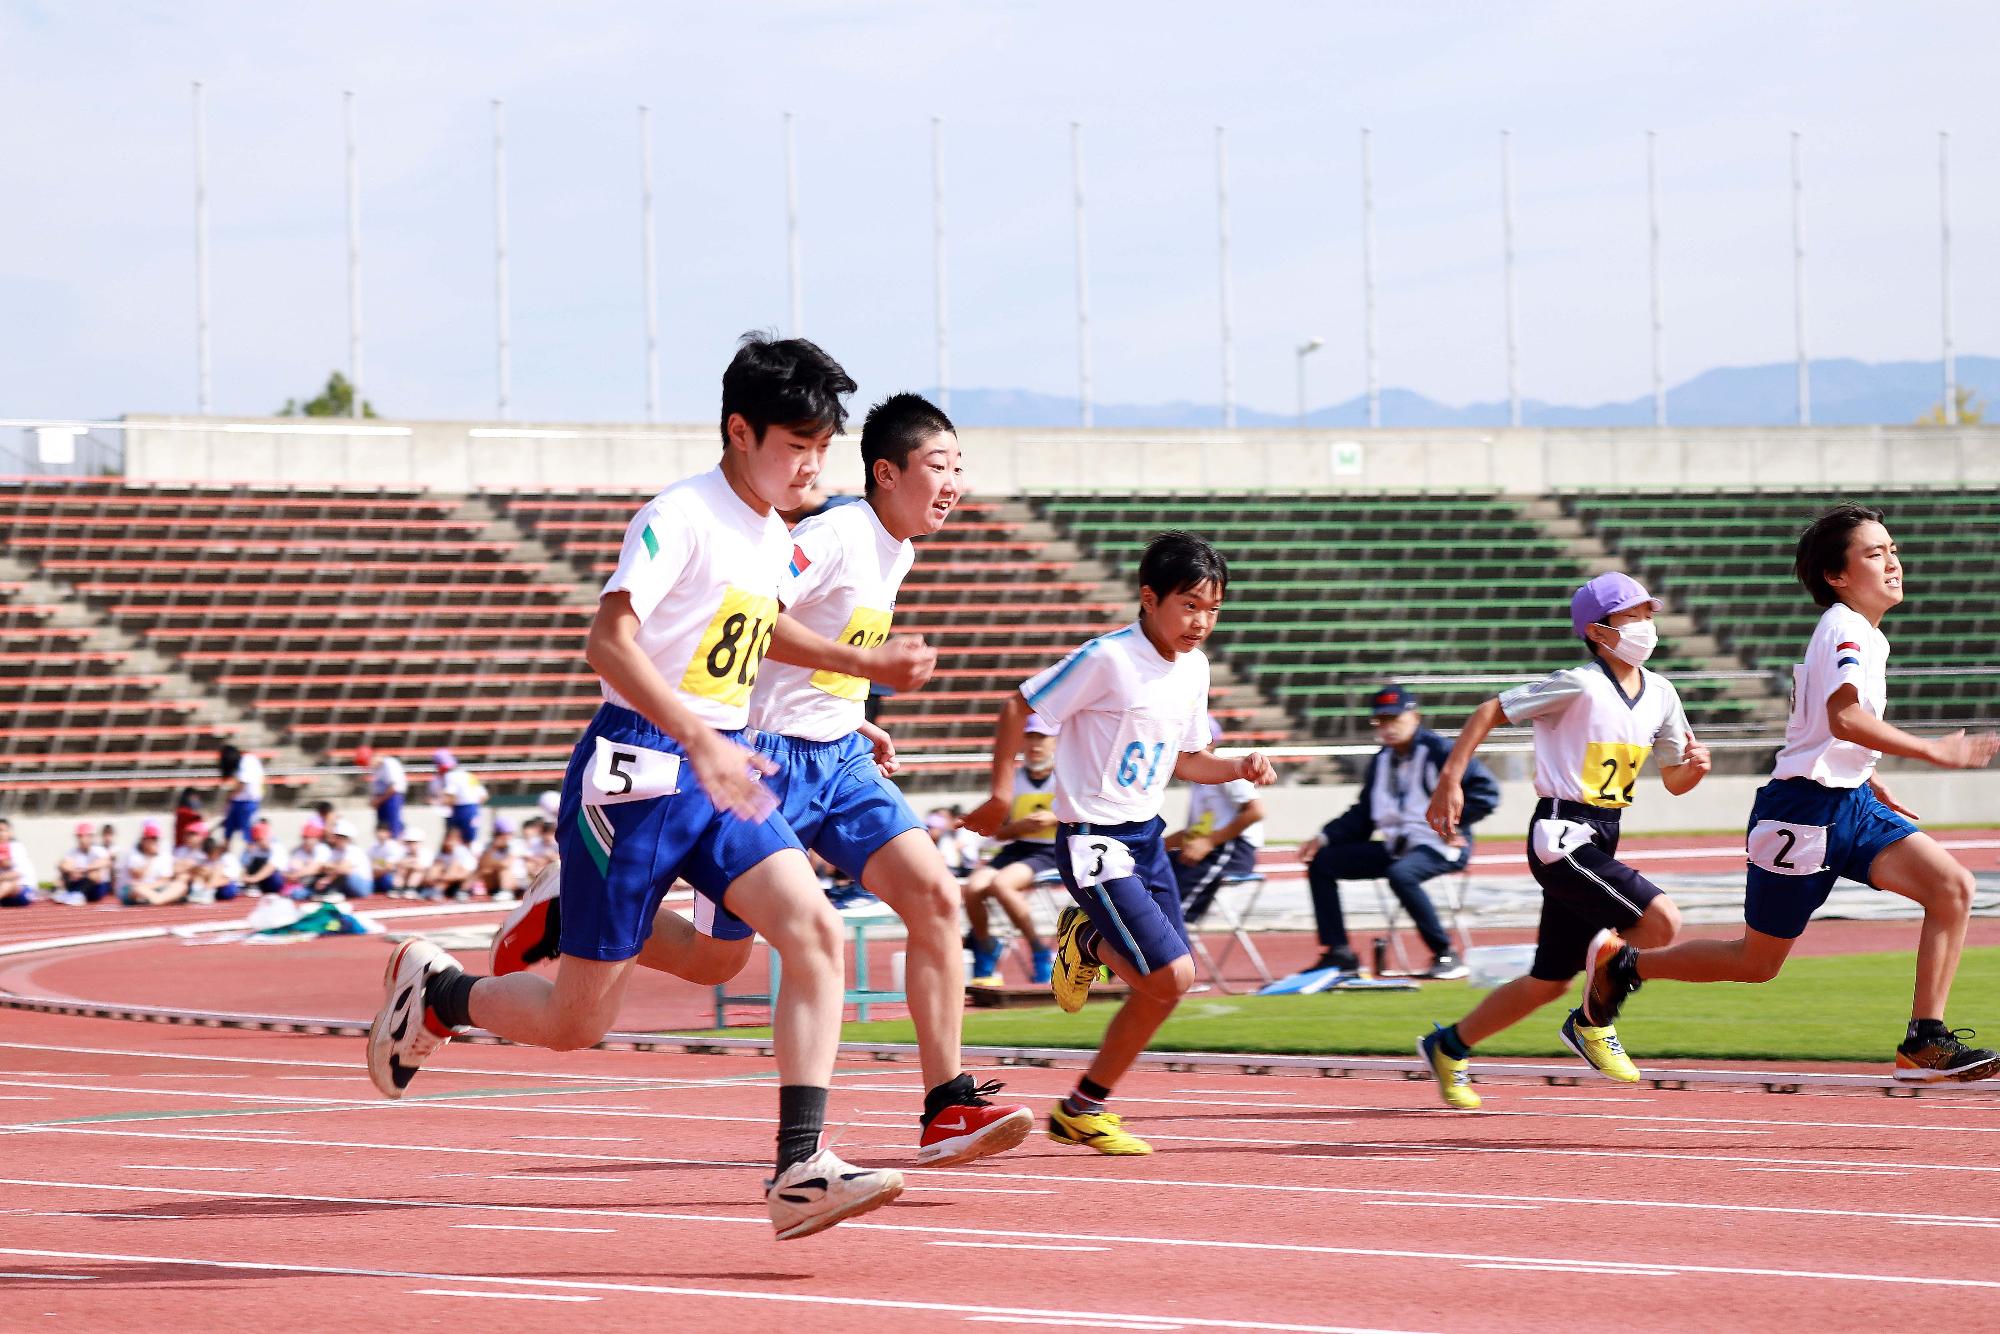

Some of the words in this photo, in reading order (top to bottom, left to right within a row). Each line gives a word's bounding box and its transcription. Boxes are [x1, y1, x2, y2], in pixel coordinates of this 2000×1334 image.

[606, 751, 637, 796] 5
[1089, 843, 1109, 877] 3
[1773, 828, 1797, 870] 2
